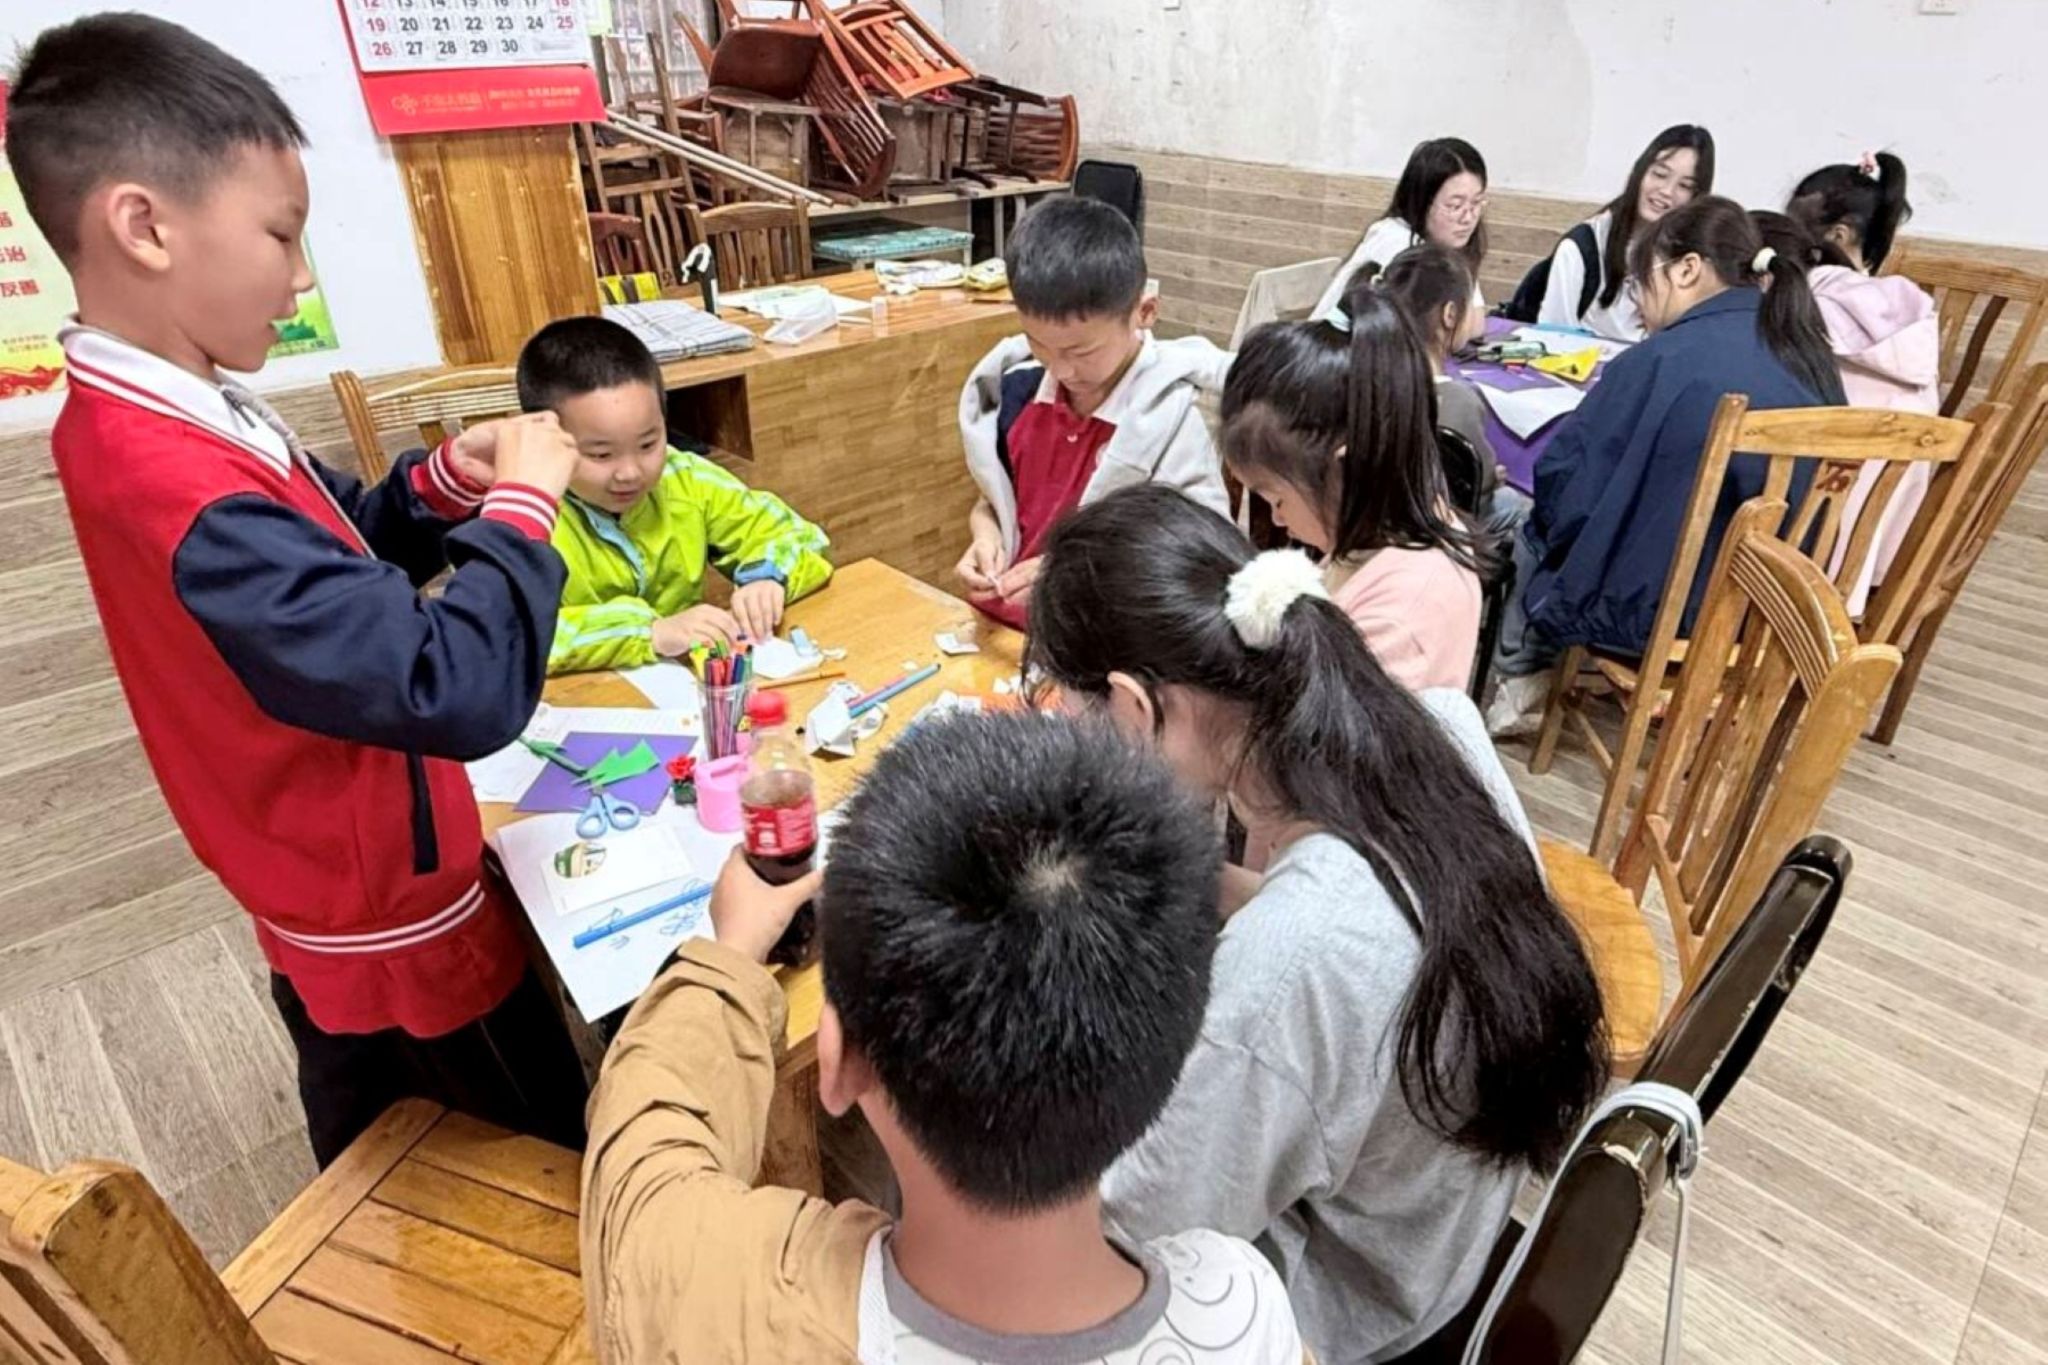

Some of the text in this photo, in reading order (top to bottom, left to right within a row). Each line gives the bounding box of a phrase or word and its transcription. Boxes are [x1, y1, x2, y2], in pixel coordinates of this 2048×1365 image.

[367, 16, 574, 32] 19 20 21 22 23 24 25
[372, 39, 519, 56] 26 27 28 29 30
[0, 245, 26, 263] 治
